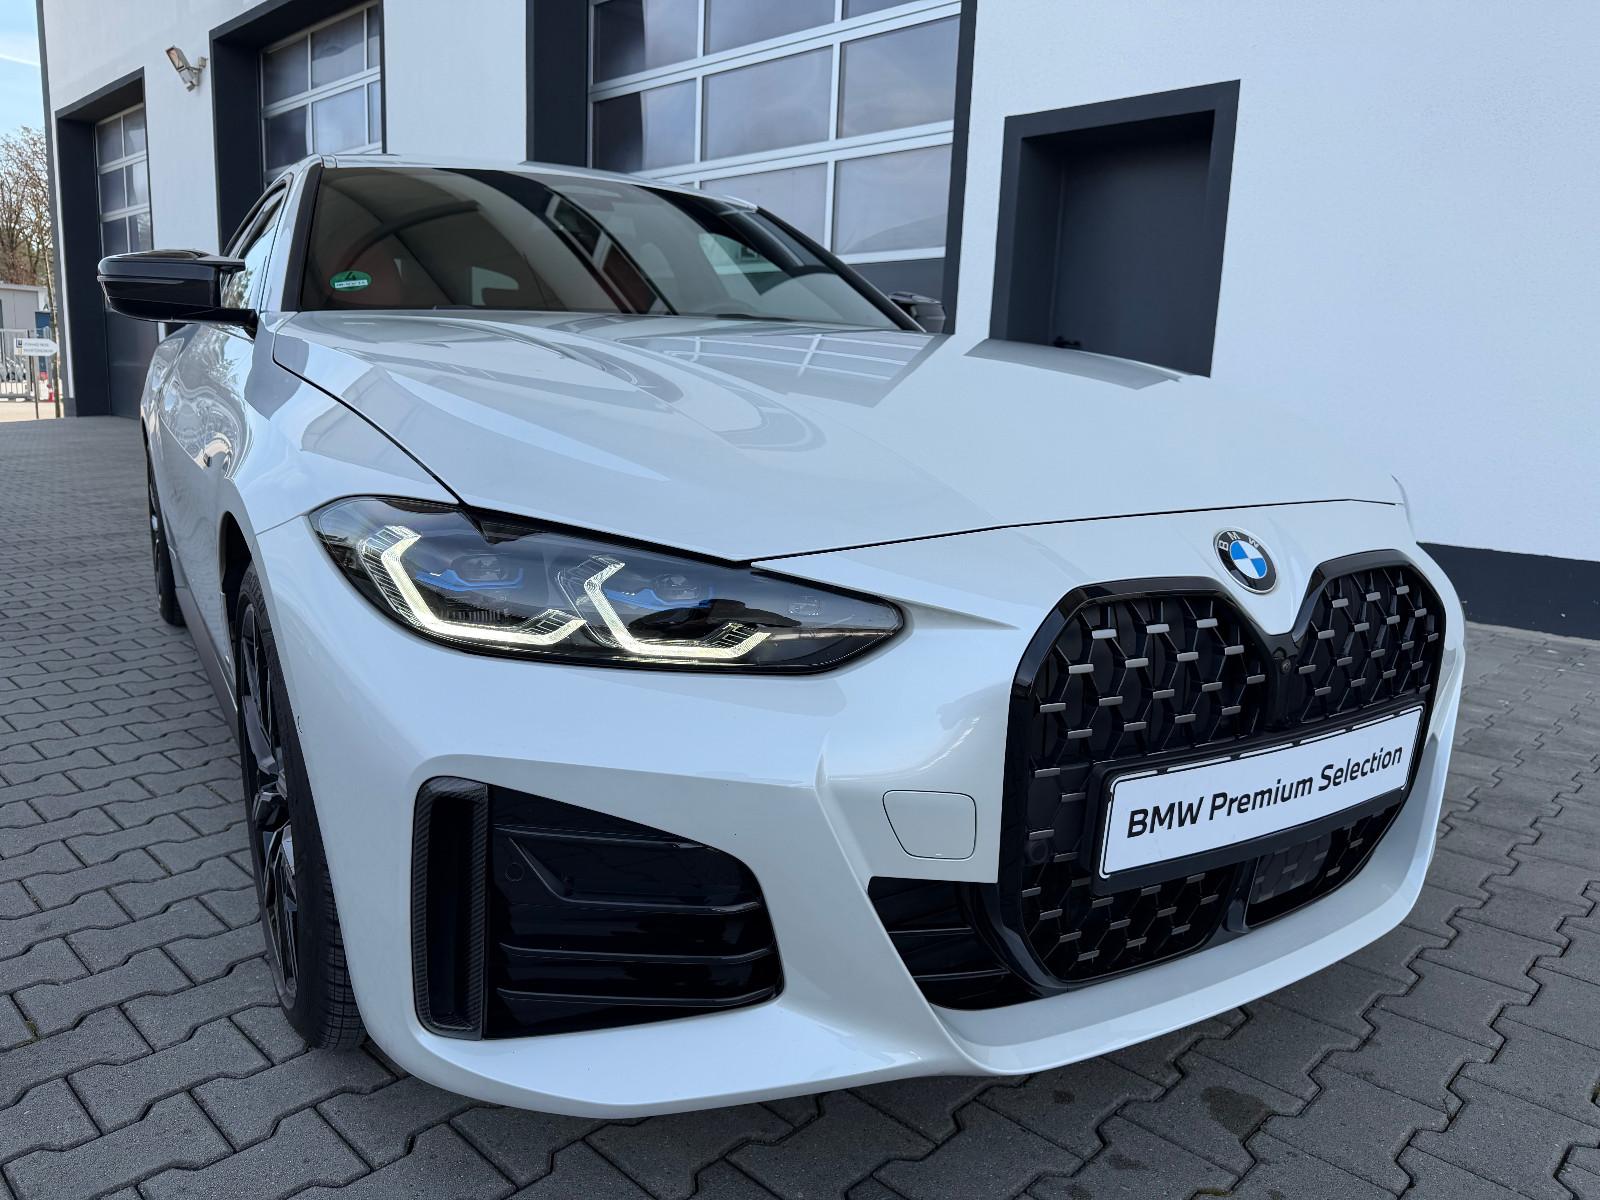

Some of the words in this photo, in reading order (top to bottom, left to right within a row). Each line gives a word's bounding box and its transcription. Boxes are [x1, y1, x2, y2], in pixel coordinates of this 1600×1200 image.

[1218, 531, 1260, 551] BMW
[1127, 796, 1205, 838] BMW
[1208, 778, 1314, 821] Premium
[1318, 746, 1403, 792] Selection
